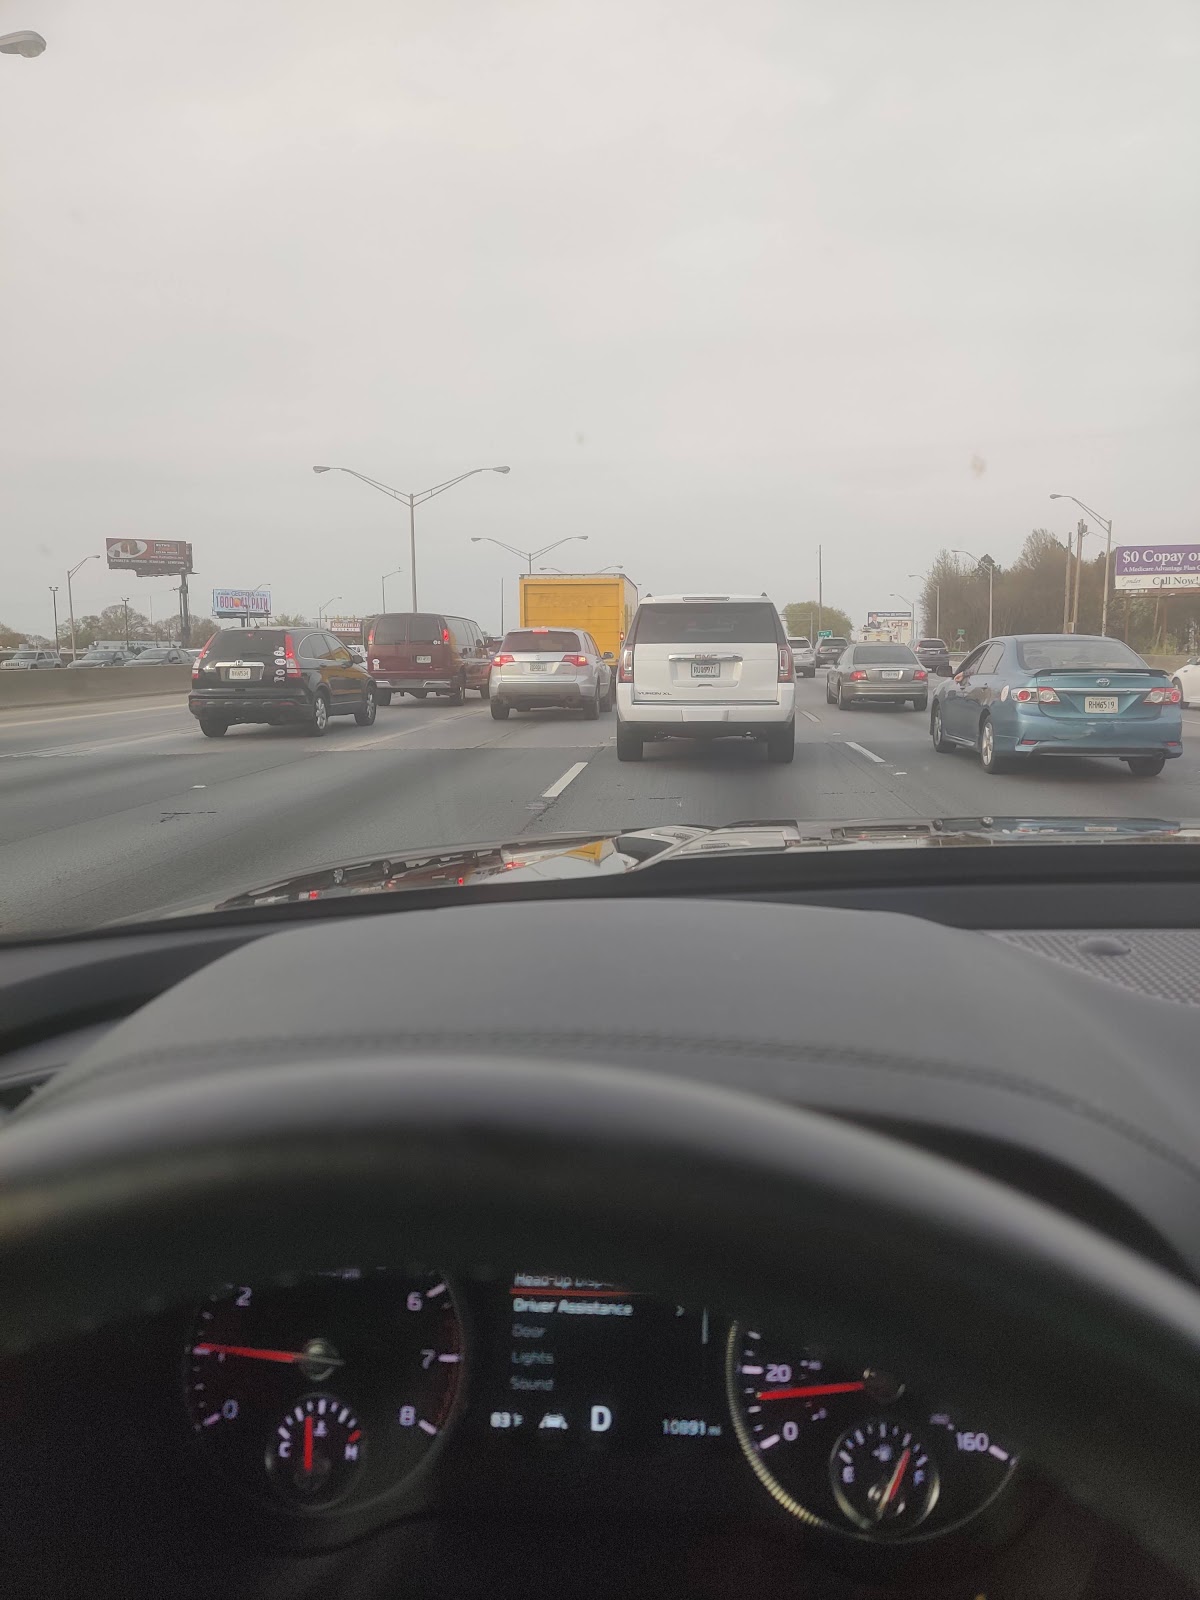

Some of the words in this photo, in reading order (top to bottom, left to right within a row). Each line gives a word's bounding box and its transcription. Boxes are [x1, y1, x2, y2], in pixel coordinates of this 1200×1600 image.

[1122, 550, 1139, 564] $0
[1142, 549, 1186, 566] Copay
[1154, 564, 1182, 573] Advantage
[1173, 576, 1199, 586] Now!
[236, 1286, 252, 1307] 2
[406, 1291, 423, 1312] 6
[513, 1297, 556, 1313] Driver
[557, 1299, 634, 1317] Assistance
[420, 1348, 436, 1370] 7
[511, 1351, 554, 1365] Lights
[765, 1364, 793, 1383] 20
[399, 1405, 416, 1427] 8
[590, 1404, 613, 1432] D
[782, 1420, 800, 1442] 0
[956, 1431, 990, 1452] 160
